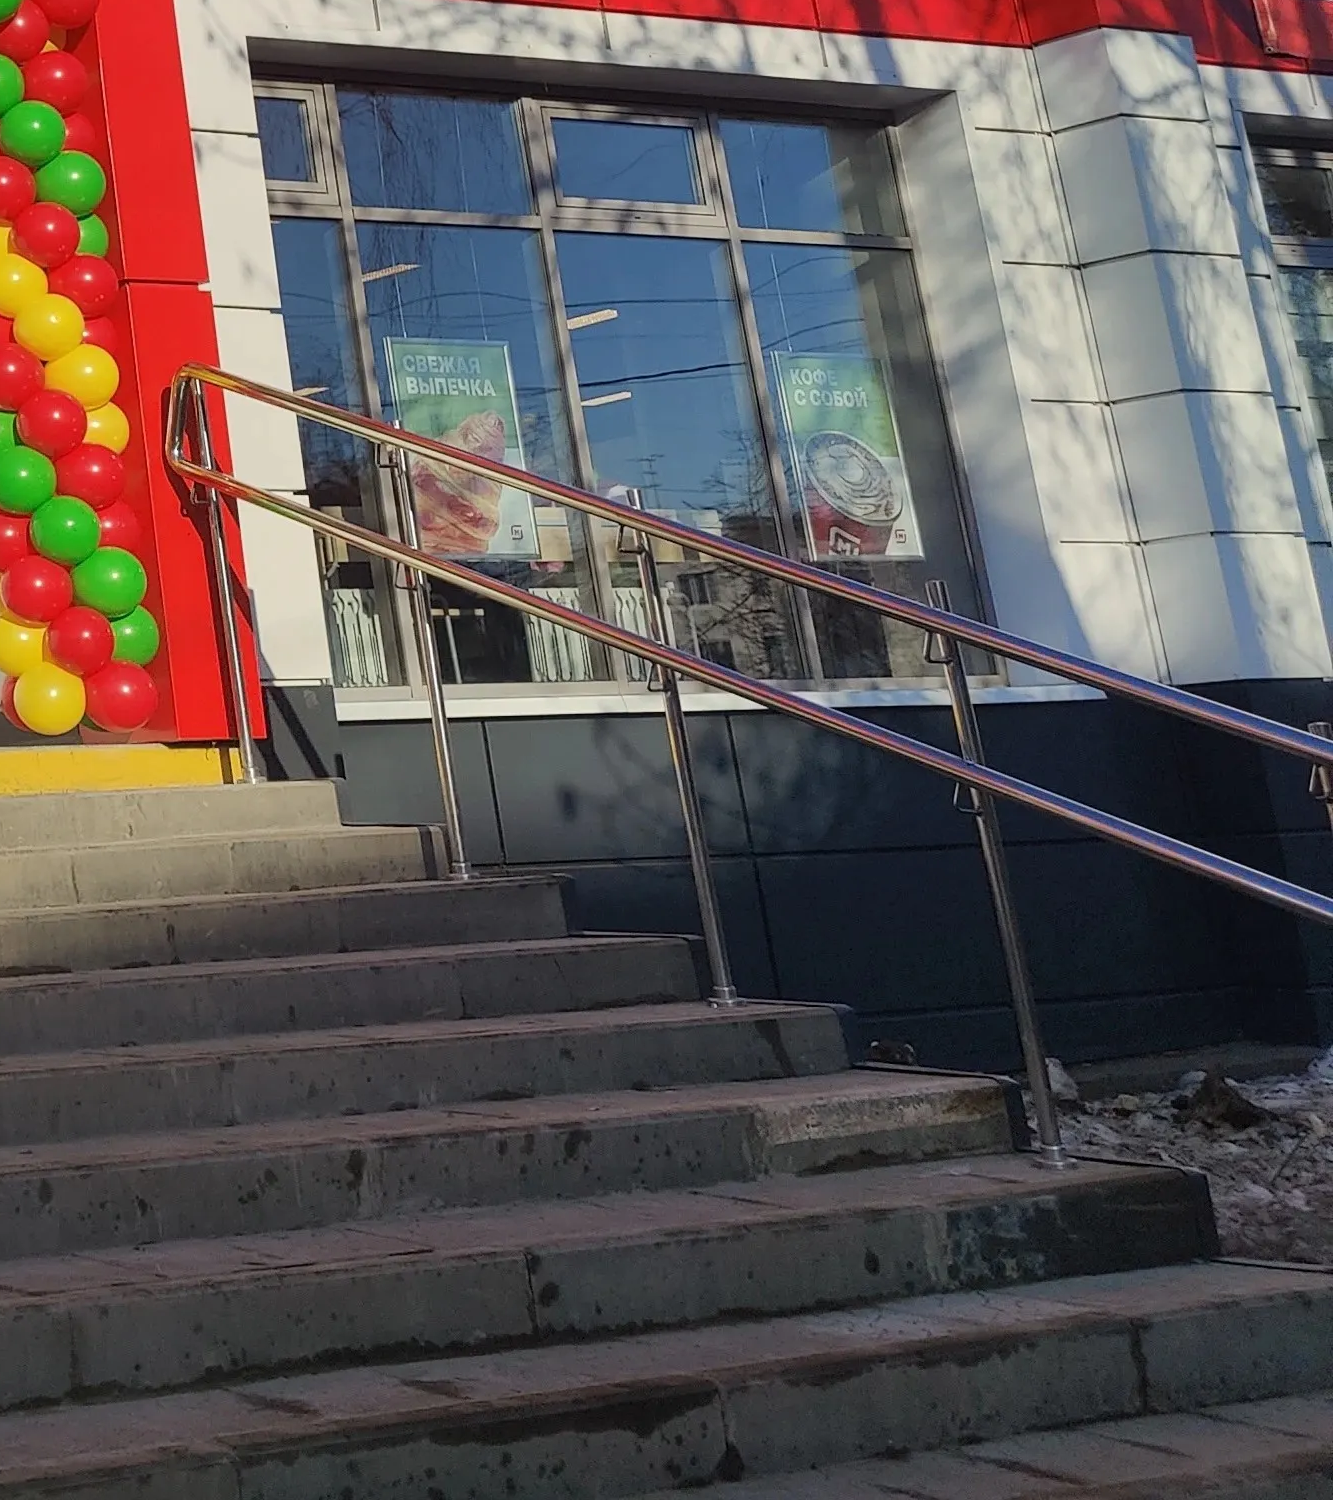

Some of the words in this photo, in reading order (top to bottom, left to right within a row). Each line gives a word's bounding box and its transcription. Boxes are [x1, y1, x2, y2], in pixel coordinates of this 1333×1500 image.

[402, 354, 482, 374] СВЕЖАЯ
[405, 376, 496, 397] ВЫПЕЧКА
[789, 368, 838, 387] КОФЕ
[794, 388, 807, 406] С
[809, 386, 868, 408] СОБОЙ
